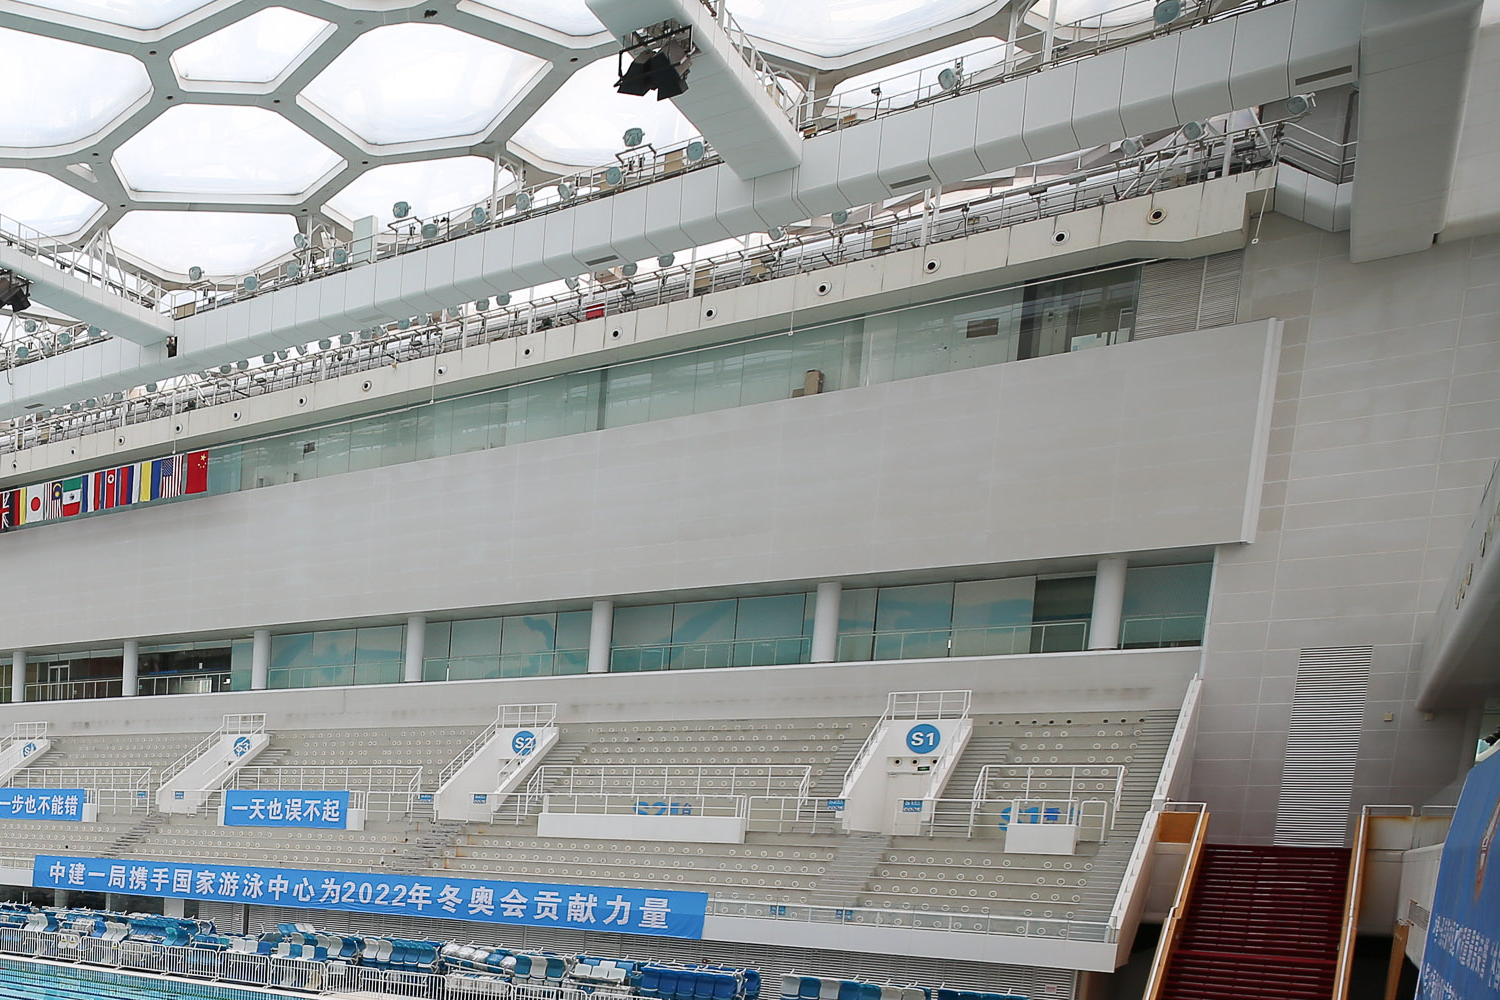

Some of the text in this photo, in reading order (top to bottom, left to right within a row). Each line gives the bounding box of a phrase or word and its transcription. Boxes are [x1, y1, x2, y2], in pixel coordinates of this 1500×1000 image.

[515, 736, 533, 749] S2
[911, 732, 935, 746] S1
[231, 797, 340, 822] 一天也误不起
[49, 860, 672, 930] 中建一局携手国家游泳中心为2022年冬奥会贡献力量
